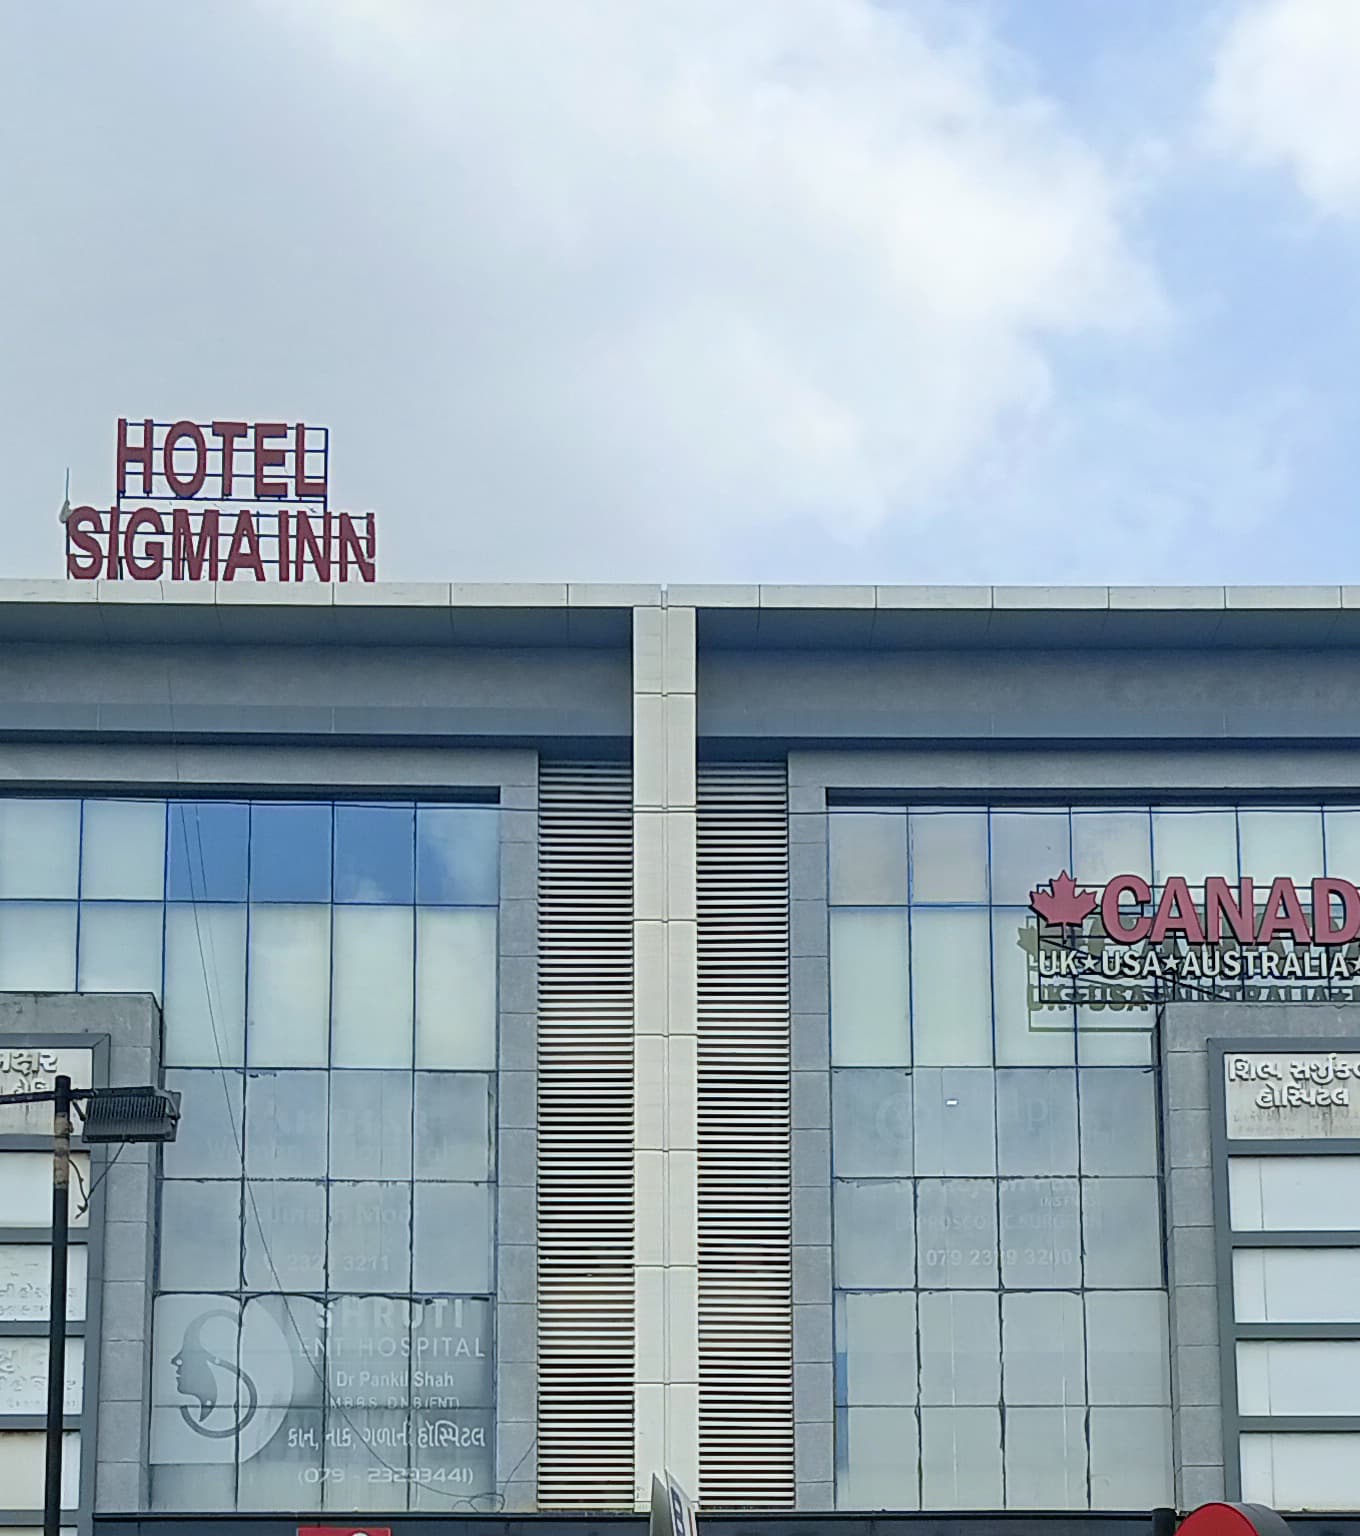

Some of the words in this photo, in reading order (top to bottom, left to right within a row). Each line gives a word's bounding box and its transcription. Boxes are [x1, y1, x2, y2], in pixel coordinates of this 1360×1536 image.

[117, 418, 327, 498] HOTEL
[1040, 950, 1078, 977] UK
[1101, 950, 1163, 977] USA
[1180, 950, 1351, 977] AUSTRALIA
[359, 1336, 485, 1358] HOSPITAL
[336, 1371, 354, 1388] Dr
[414, 1371, 455, 1388] Shah
